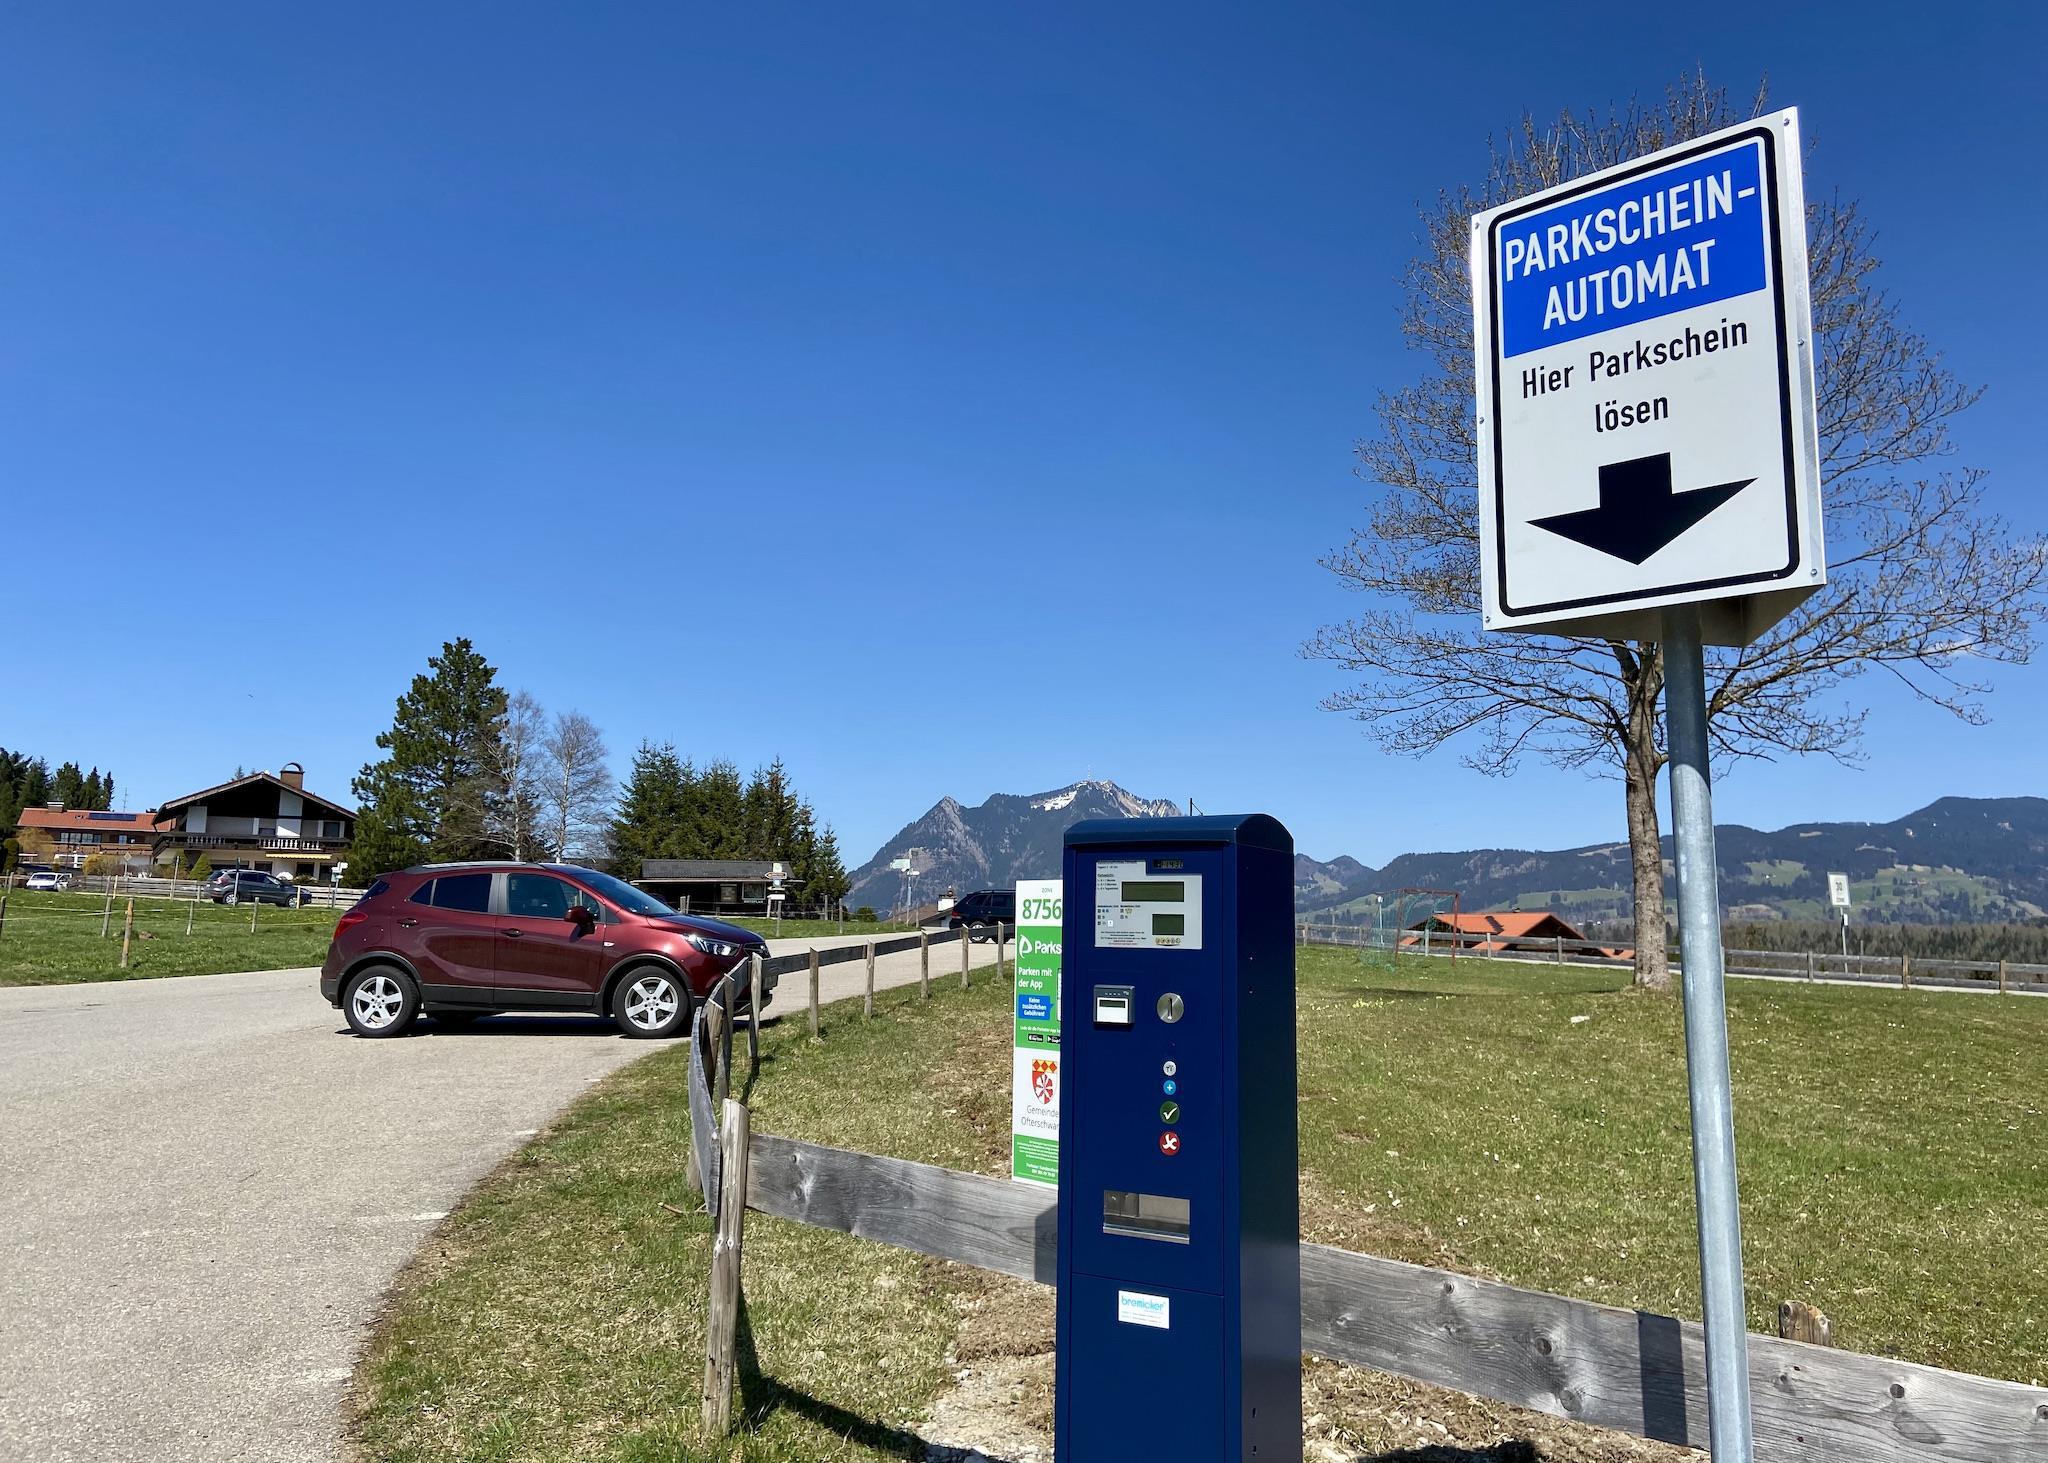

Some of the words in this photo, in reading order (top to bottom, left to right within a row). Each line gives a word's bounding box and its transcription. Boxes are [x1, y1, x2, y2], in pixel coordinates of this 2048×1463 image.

[1505, 169, 1756, 282] PARKSCHEIN-
[1542, 238, 1716, 331] AUTOMAT
[1522, 362, 1574, 399] Hier
[1590, 318, 1749, 382] Parkschein
[1595, 395, 1670, 434] lösen
[1022, 898, 1062, 920] 8756
[1018, 967, 1040, 976] Parken
[1041, 967, 1053, 977] mit
[1018, 979, 1029, 988] der
[1030, 980, 1043, 990] App
[1026, 1105, 1059, 1118] Gemeinde
[1121, 1295, 1164, 1310] bremicker
